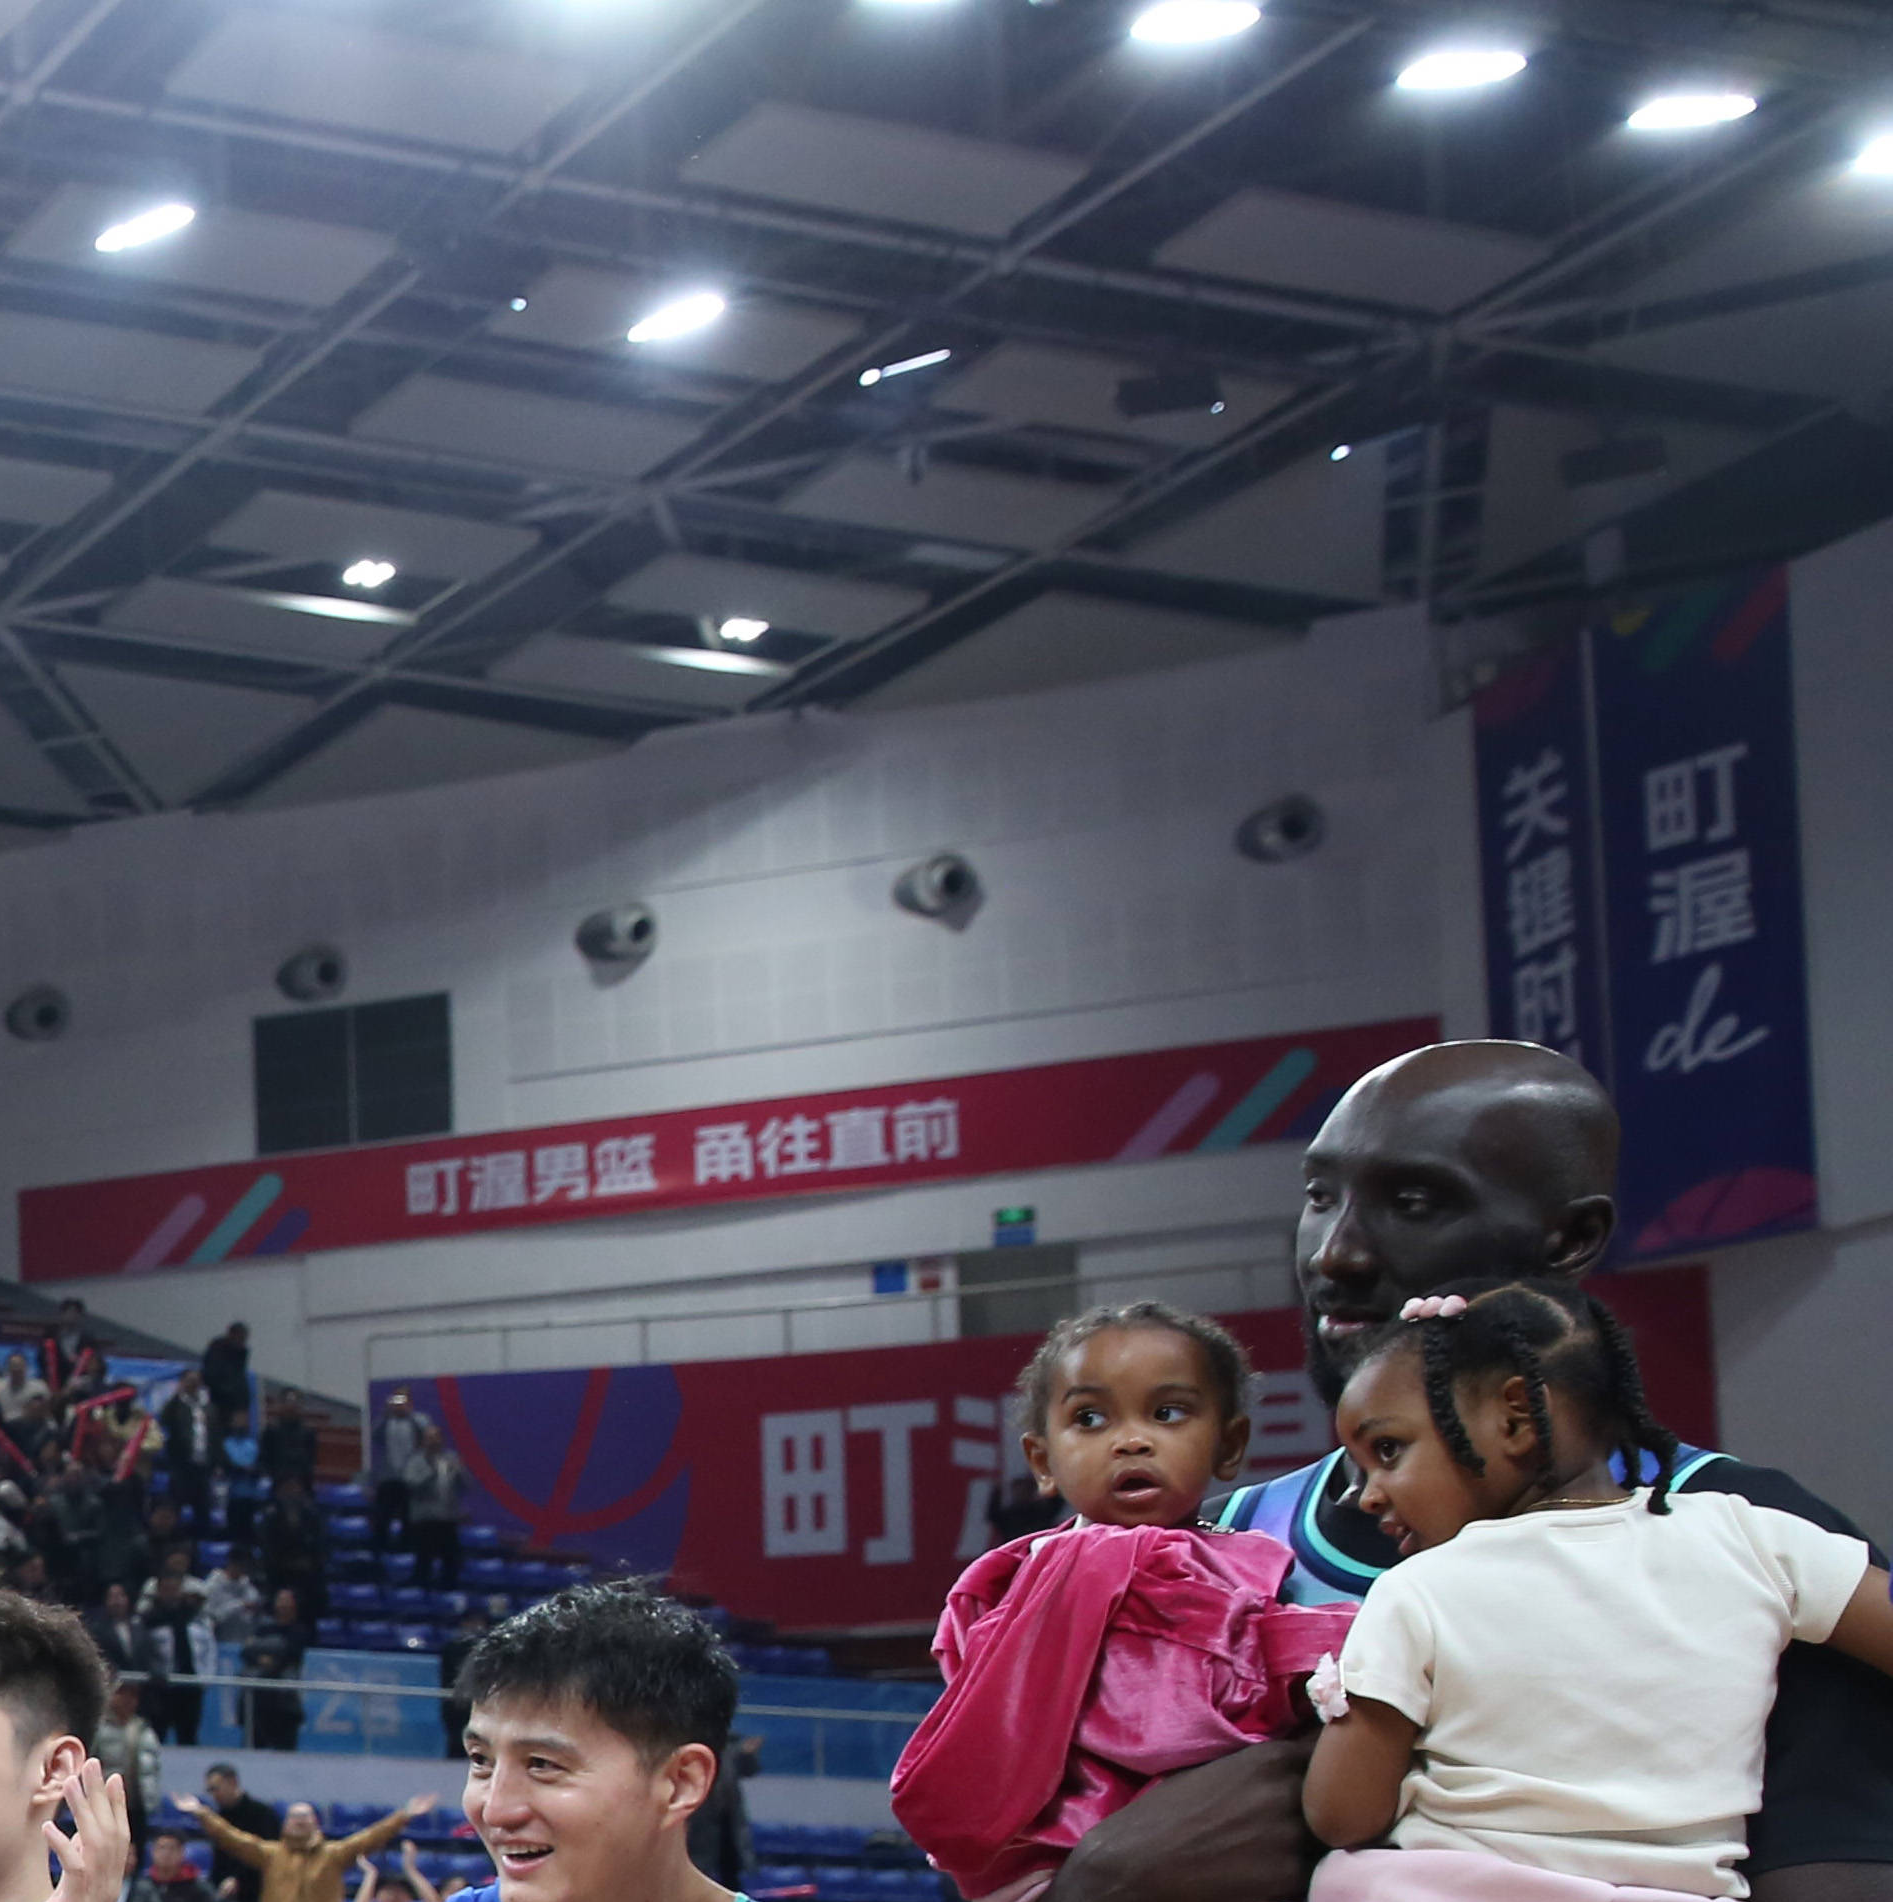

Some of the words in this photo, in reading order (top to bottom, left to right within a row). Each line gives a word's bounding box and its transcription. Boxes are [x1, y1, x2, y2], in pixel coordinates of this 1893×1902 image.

[1502, 746, 1582, 1074] 关键时
[1643, 744, 1757, 961] 町渥
[1644, 962, 1769, 1074] de
[404, 1131, 659, 1216] 町渥男篮
[693, 1097, 961, 1186] 甬往直前
